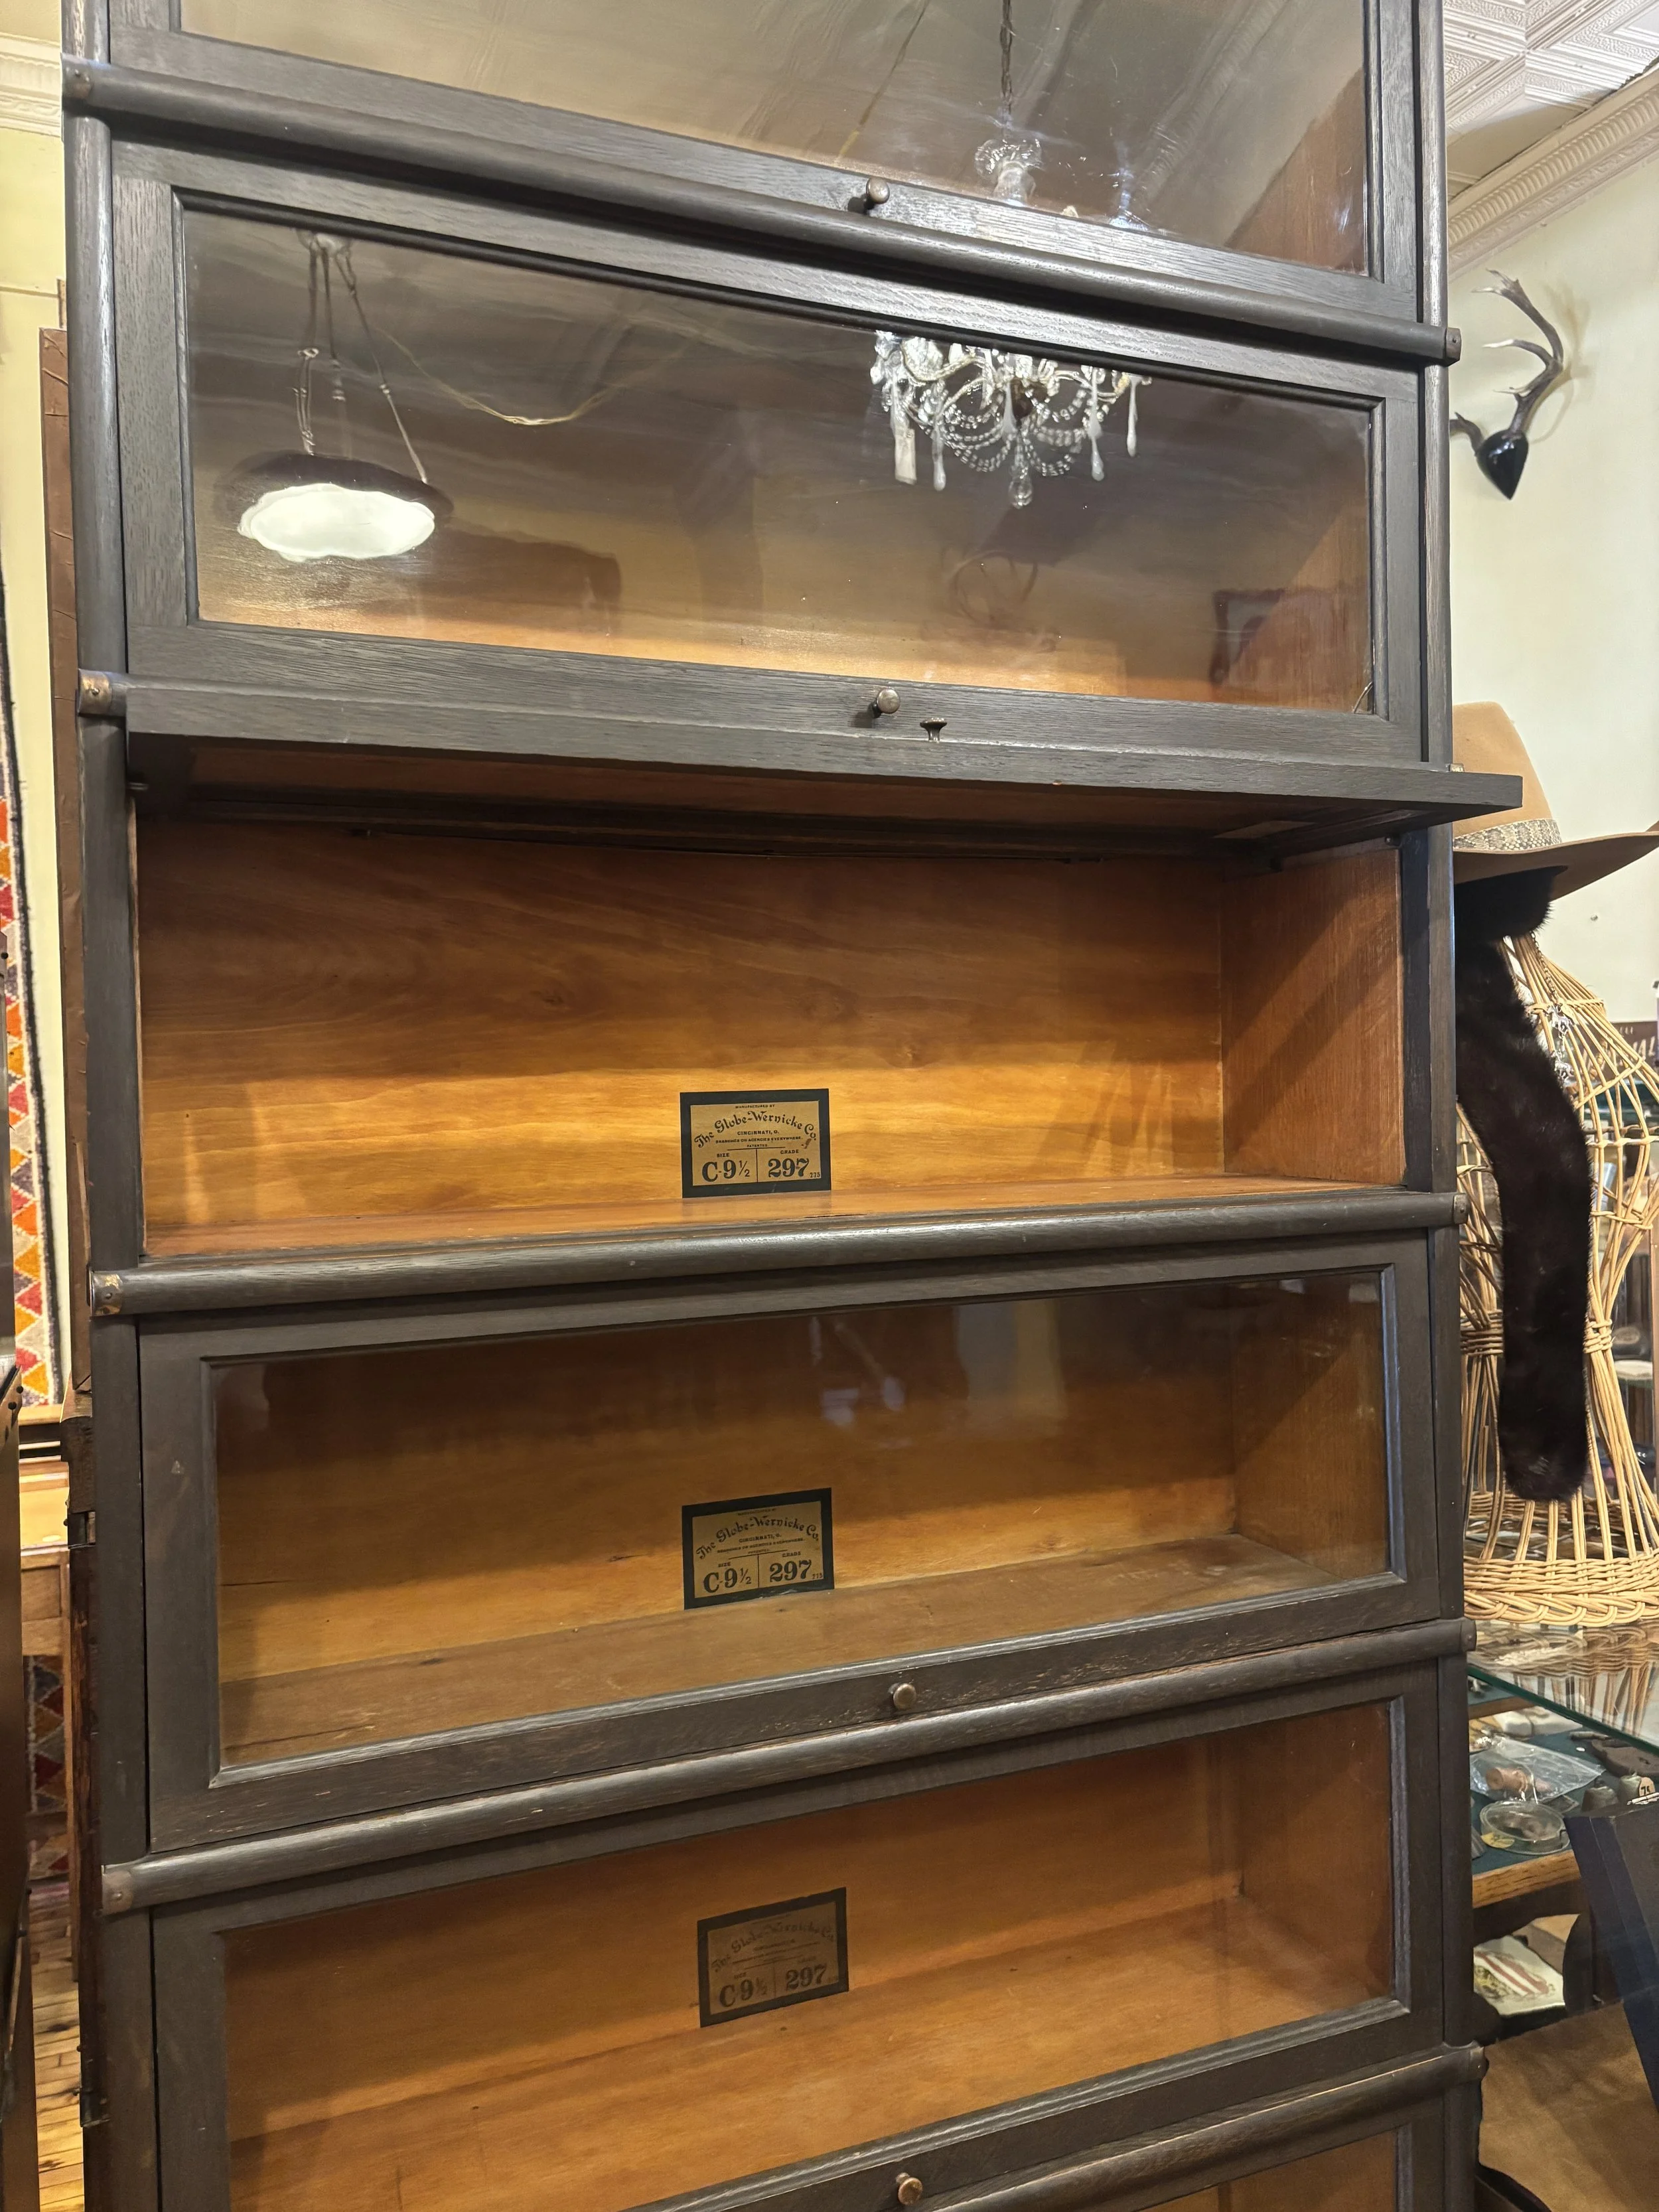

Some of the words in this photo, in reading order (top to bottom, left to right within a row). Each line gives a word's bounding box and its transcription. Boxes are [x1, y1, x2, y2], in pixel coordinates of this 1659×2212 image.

[693, 1132, 715, 1148] The
[714, 1110, 803, 1134] Globe-Wernicke
[804, 1124, 816, 1141] Co.
[767, 1157, 810, 1178] 297
[695, 1542, 717, 1560] The
[716, 1516, 805, 1543] Globe-Wernicke
[769, 1559, 812, 1583] 297
[784, 1963, 828, 1991] 297
